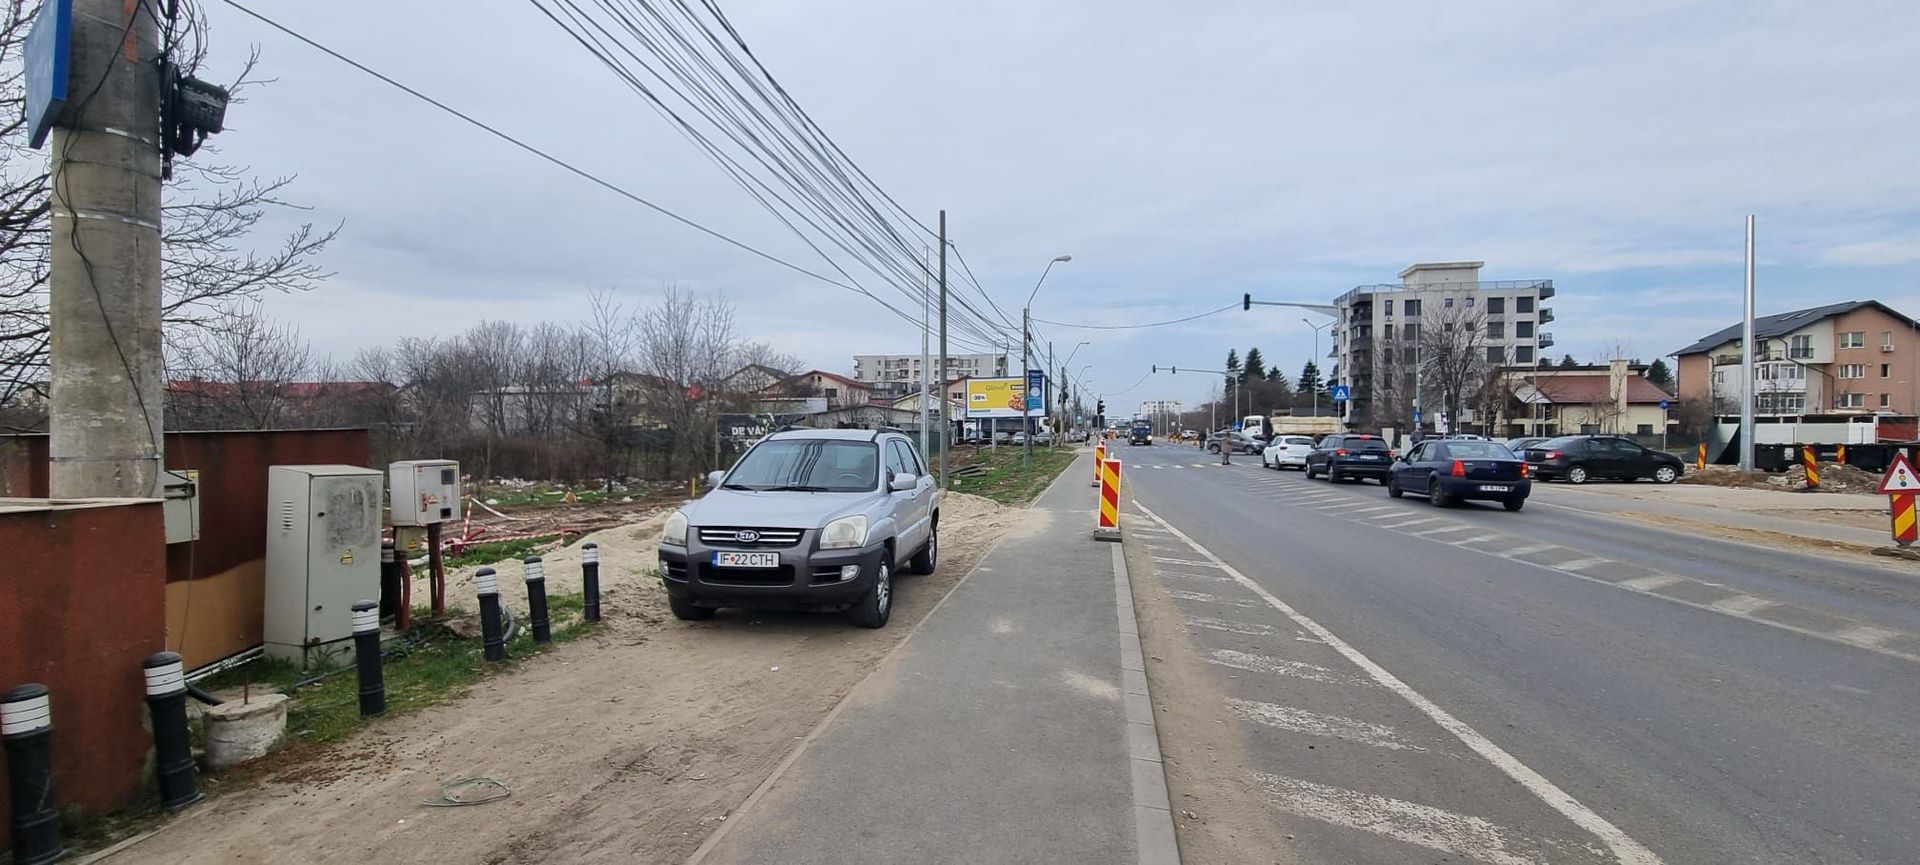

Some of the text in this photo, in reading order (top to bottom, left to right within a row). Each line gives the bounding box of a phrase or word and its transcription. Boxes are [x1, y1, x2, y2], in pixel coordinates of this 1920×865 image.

[731, 426, 746, 436] DE
[739, 532, 755, 540] KIA
[734, 554, 748, 566] 22
[749, 554, 774, 566] CTH
